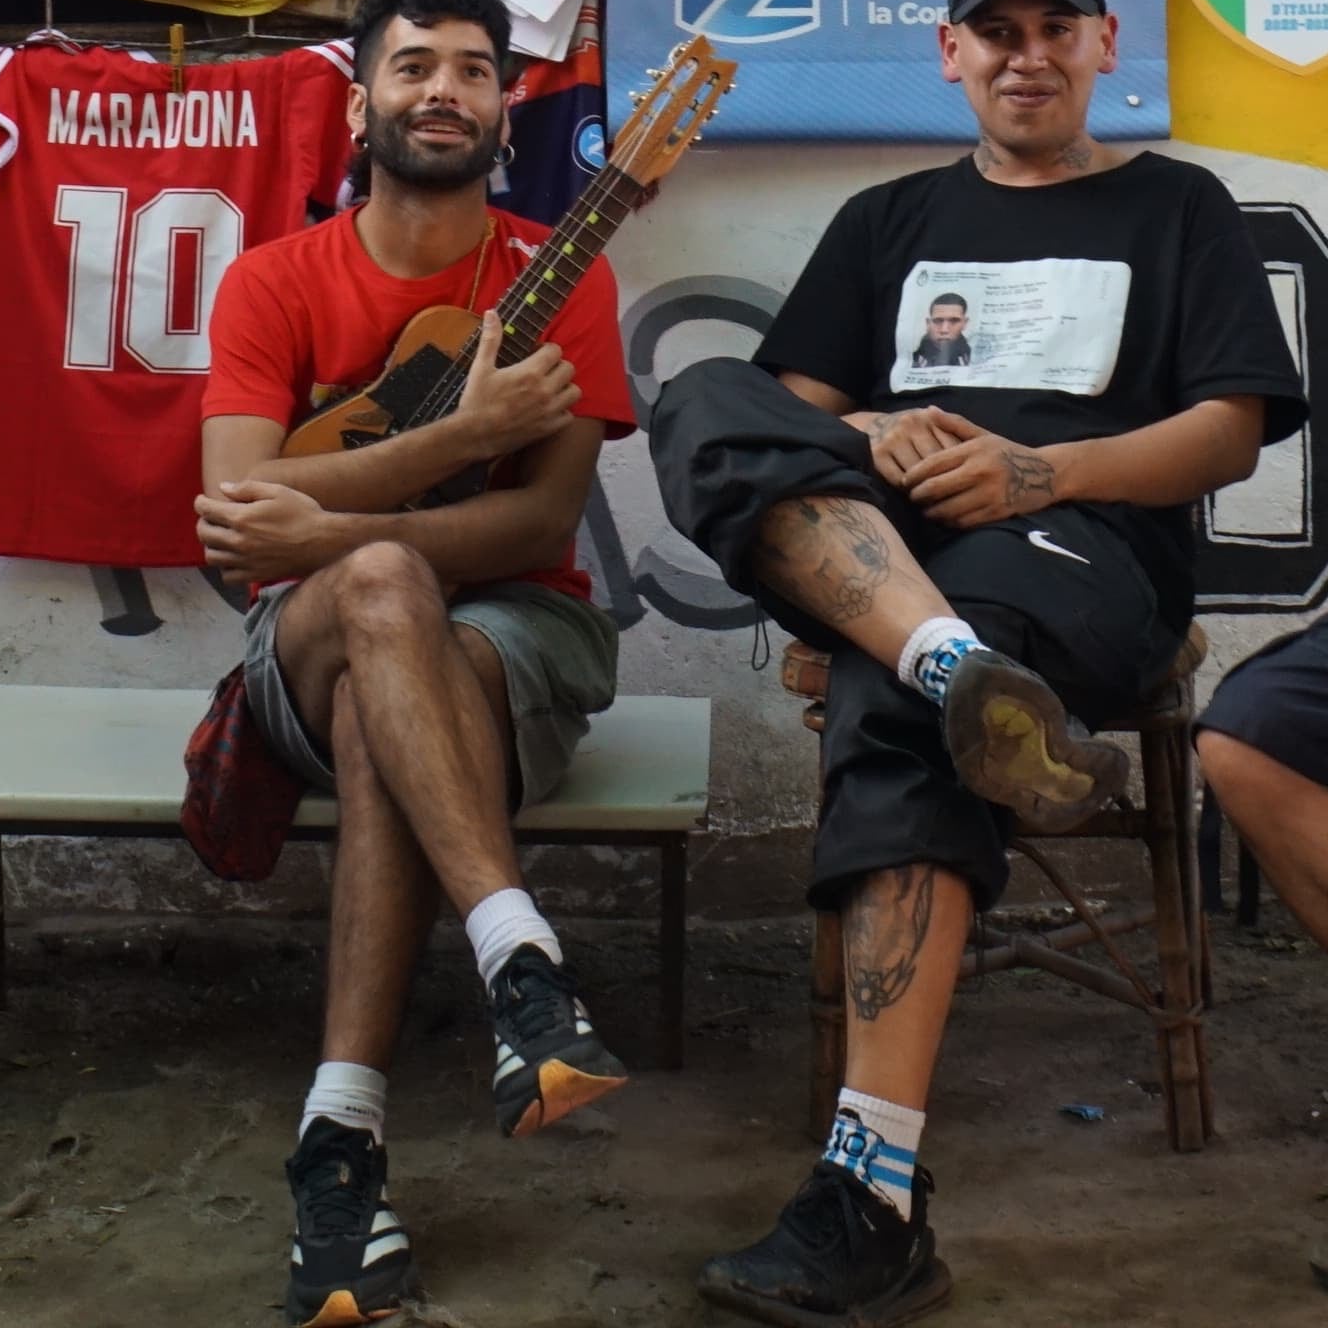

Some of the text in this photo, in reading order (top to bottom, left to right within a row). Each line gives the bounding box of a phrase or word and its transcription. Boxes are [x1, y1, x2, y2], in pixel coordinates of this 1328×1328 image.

[868, 1, 892, 24] la
[47, 89, 258, 150] MARADONA
[52, 183, 246, 376] 10
